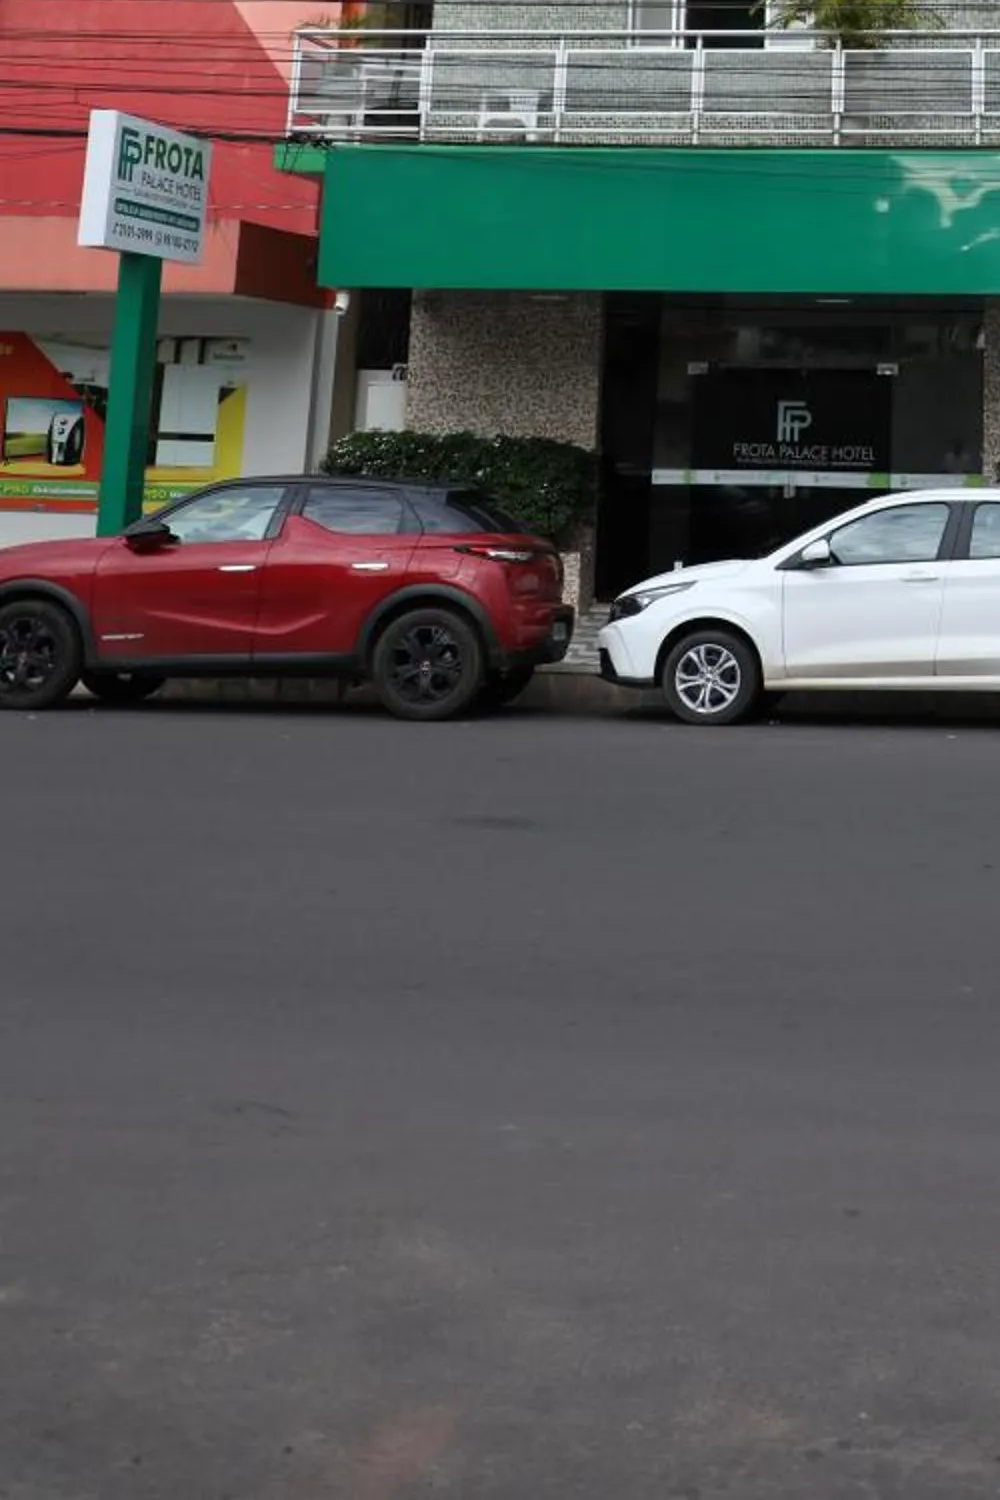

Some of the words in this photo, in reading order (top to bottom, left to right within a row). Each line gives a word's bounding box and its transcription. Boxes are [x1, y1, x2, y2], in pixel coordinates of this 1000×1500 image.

[144, 135, 204, 181] FROTA
[142, 171, 174, 194] PALACE
[175, 181, 201, 201] HOTEL
[733, 443, 775, 458] FROTA
[779, 444, 829, 461] PALACE
[831, 445, 876, 461] HOTEL
